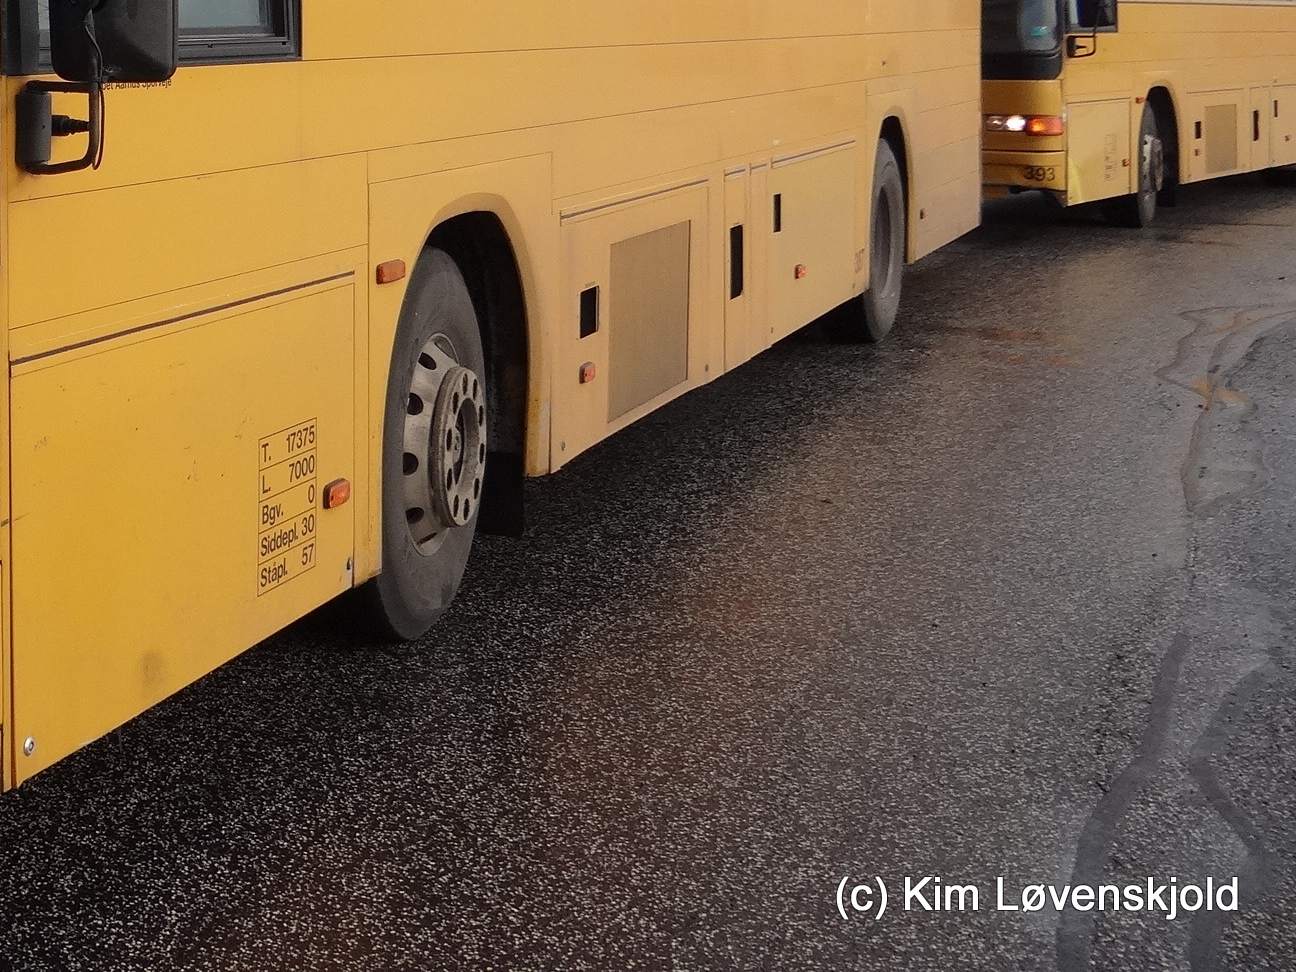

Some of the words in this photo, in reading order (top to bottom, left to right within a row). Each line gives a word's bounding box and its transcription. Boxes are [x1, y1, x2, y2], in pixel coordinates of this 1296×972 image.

[261, 442, 271, 462] T.
[286, 424, 315, 453] 17375
[262, 475, 271, 494] L.
[289, 454, 315, 483] 7000
[262, 503, 284, 526] Bgv.
[308, 484, 315, 503] 0
[260, 522, 298, 557] Siddepl.
[301, 513, 315, 536] 30
[260, 557, 288, 588] Ståpl.
[301, 543, 314, 566] 57
